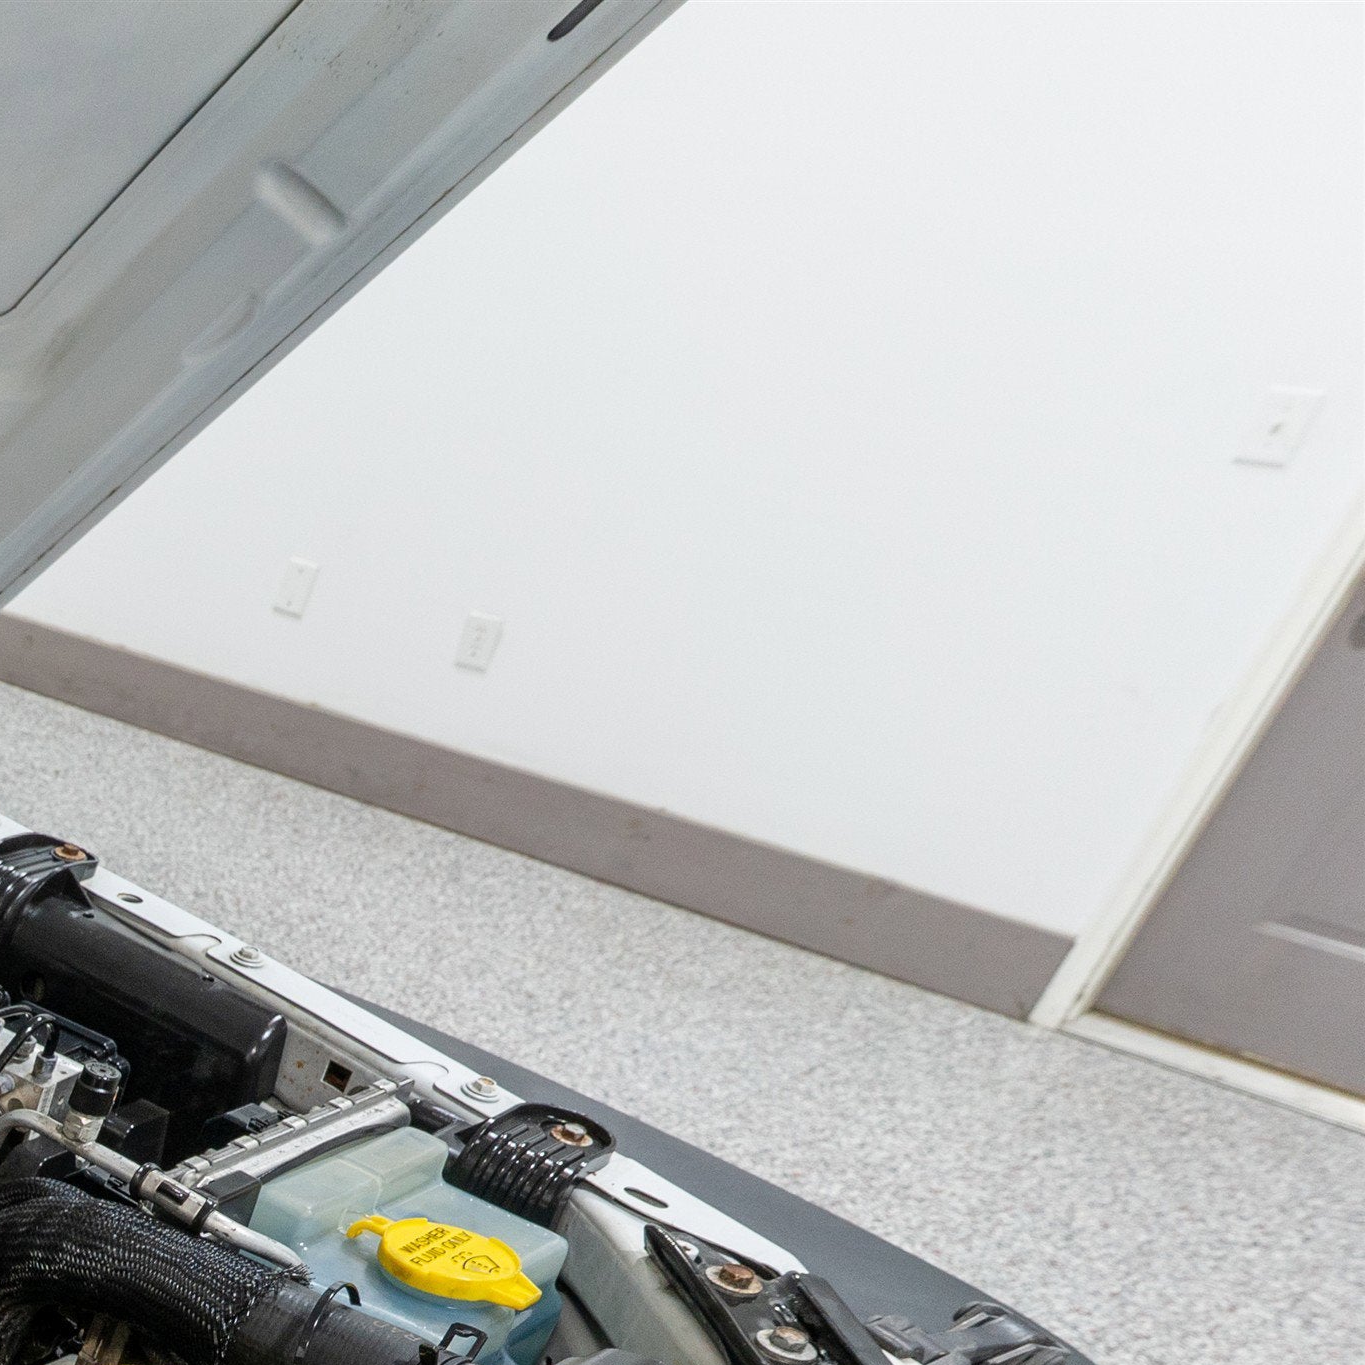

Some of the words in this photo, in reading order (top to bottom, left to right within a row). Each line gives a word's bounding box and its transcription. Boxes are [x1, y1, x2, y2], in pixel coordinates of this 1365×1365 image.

[399, 1227, 450, 1255] WASHER
[410, 1246, 447, 1267] FLUID
[443, 1231, 473, 1251] ONLY
